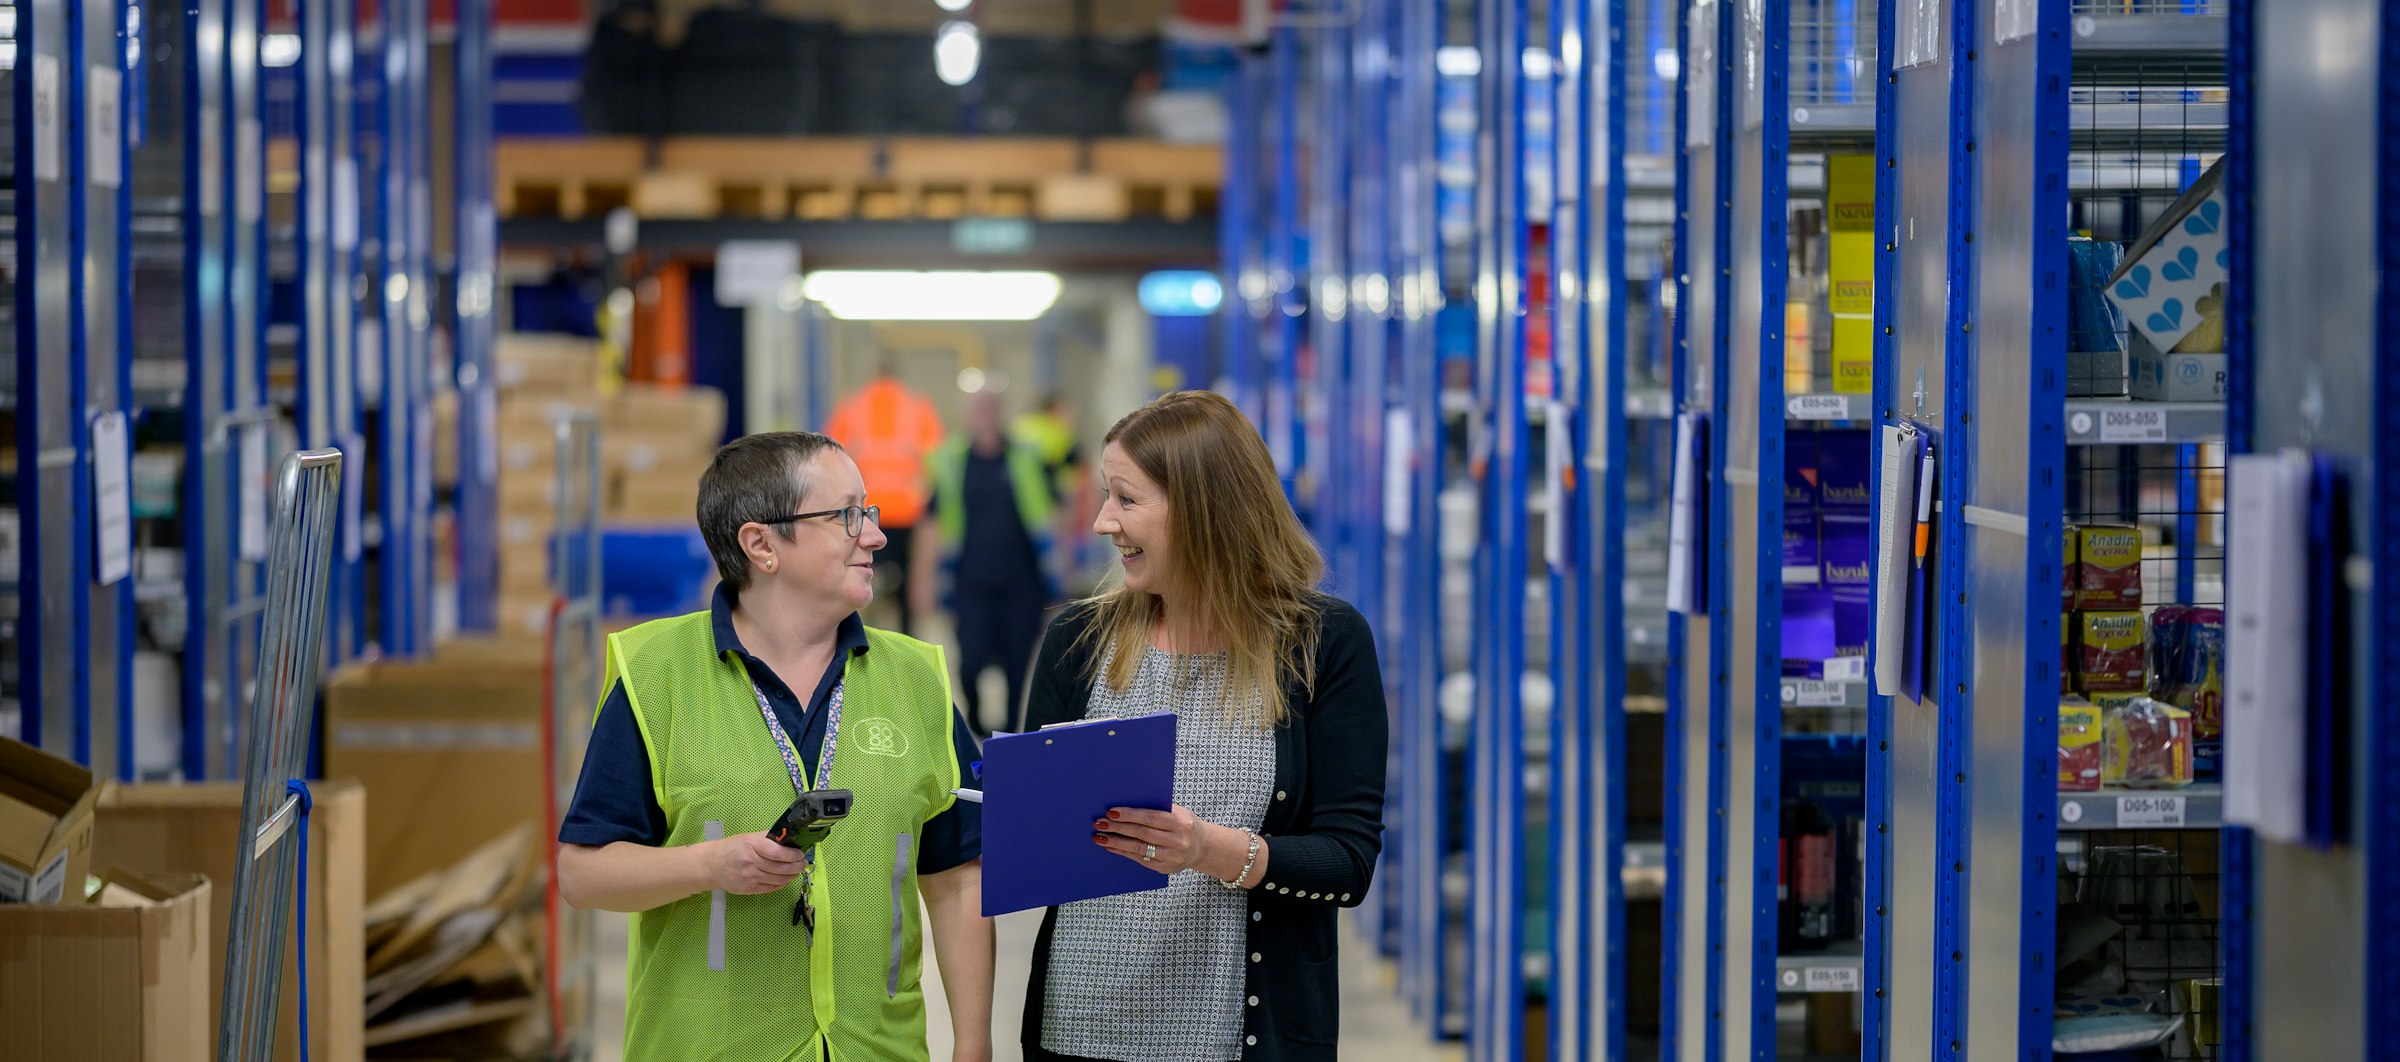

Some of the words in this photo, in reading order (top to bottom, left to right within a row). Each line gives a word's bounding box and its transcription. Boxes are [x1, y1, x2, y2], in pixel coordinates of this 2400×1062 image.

[2182, 364, 2198, 376] 70
[1802, 397, 1840, 408] E05-050
[2106, 411, 2158, 426] D05-050
[2087, 533, 2135, 548] Anadin
[2094, 548, 2129, 557] EXTRA
[2091, 616, 2136, 629] Anadin
[2096, 630, 2131, 639] EXTRA
[1801, 681, 1839, 693] E05-100
[2124, 799, 2176, 813] D05-100
[1812, 971, 1850, 981] E05-150
